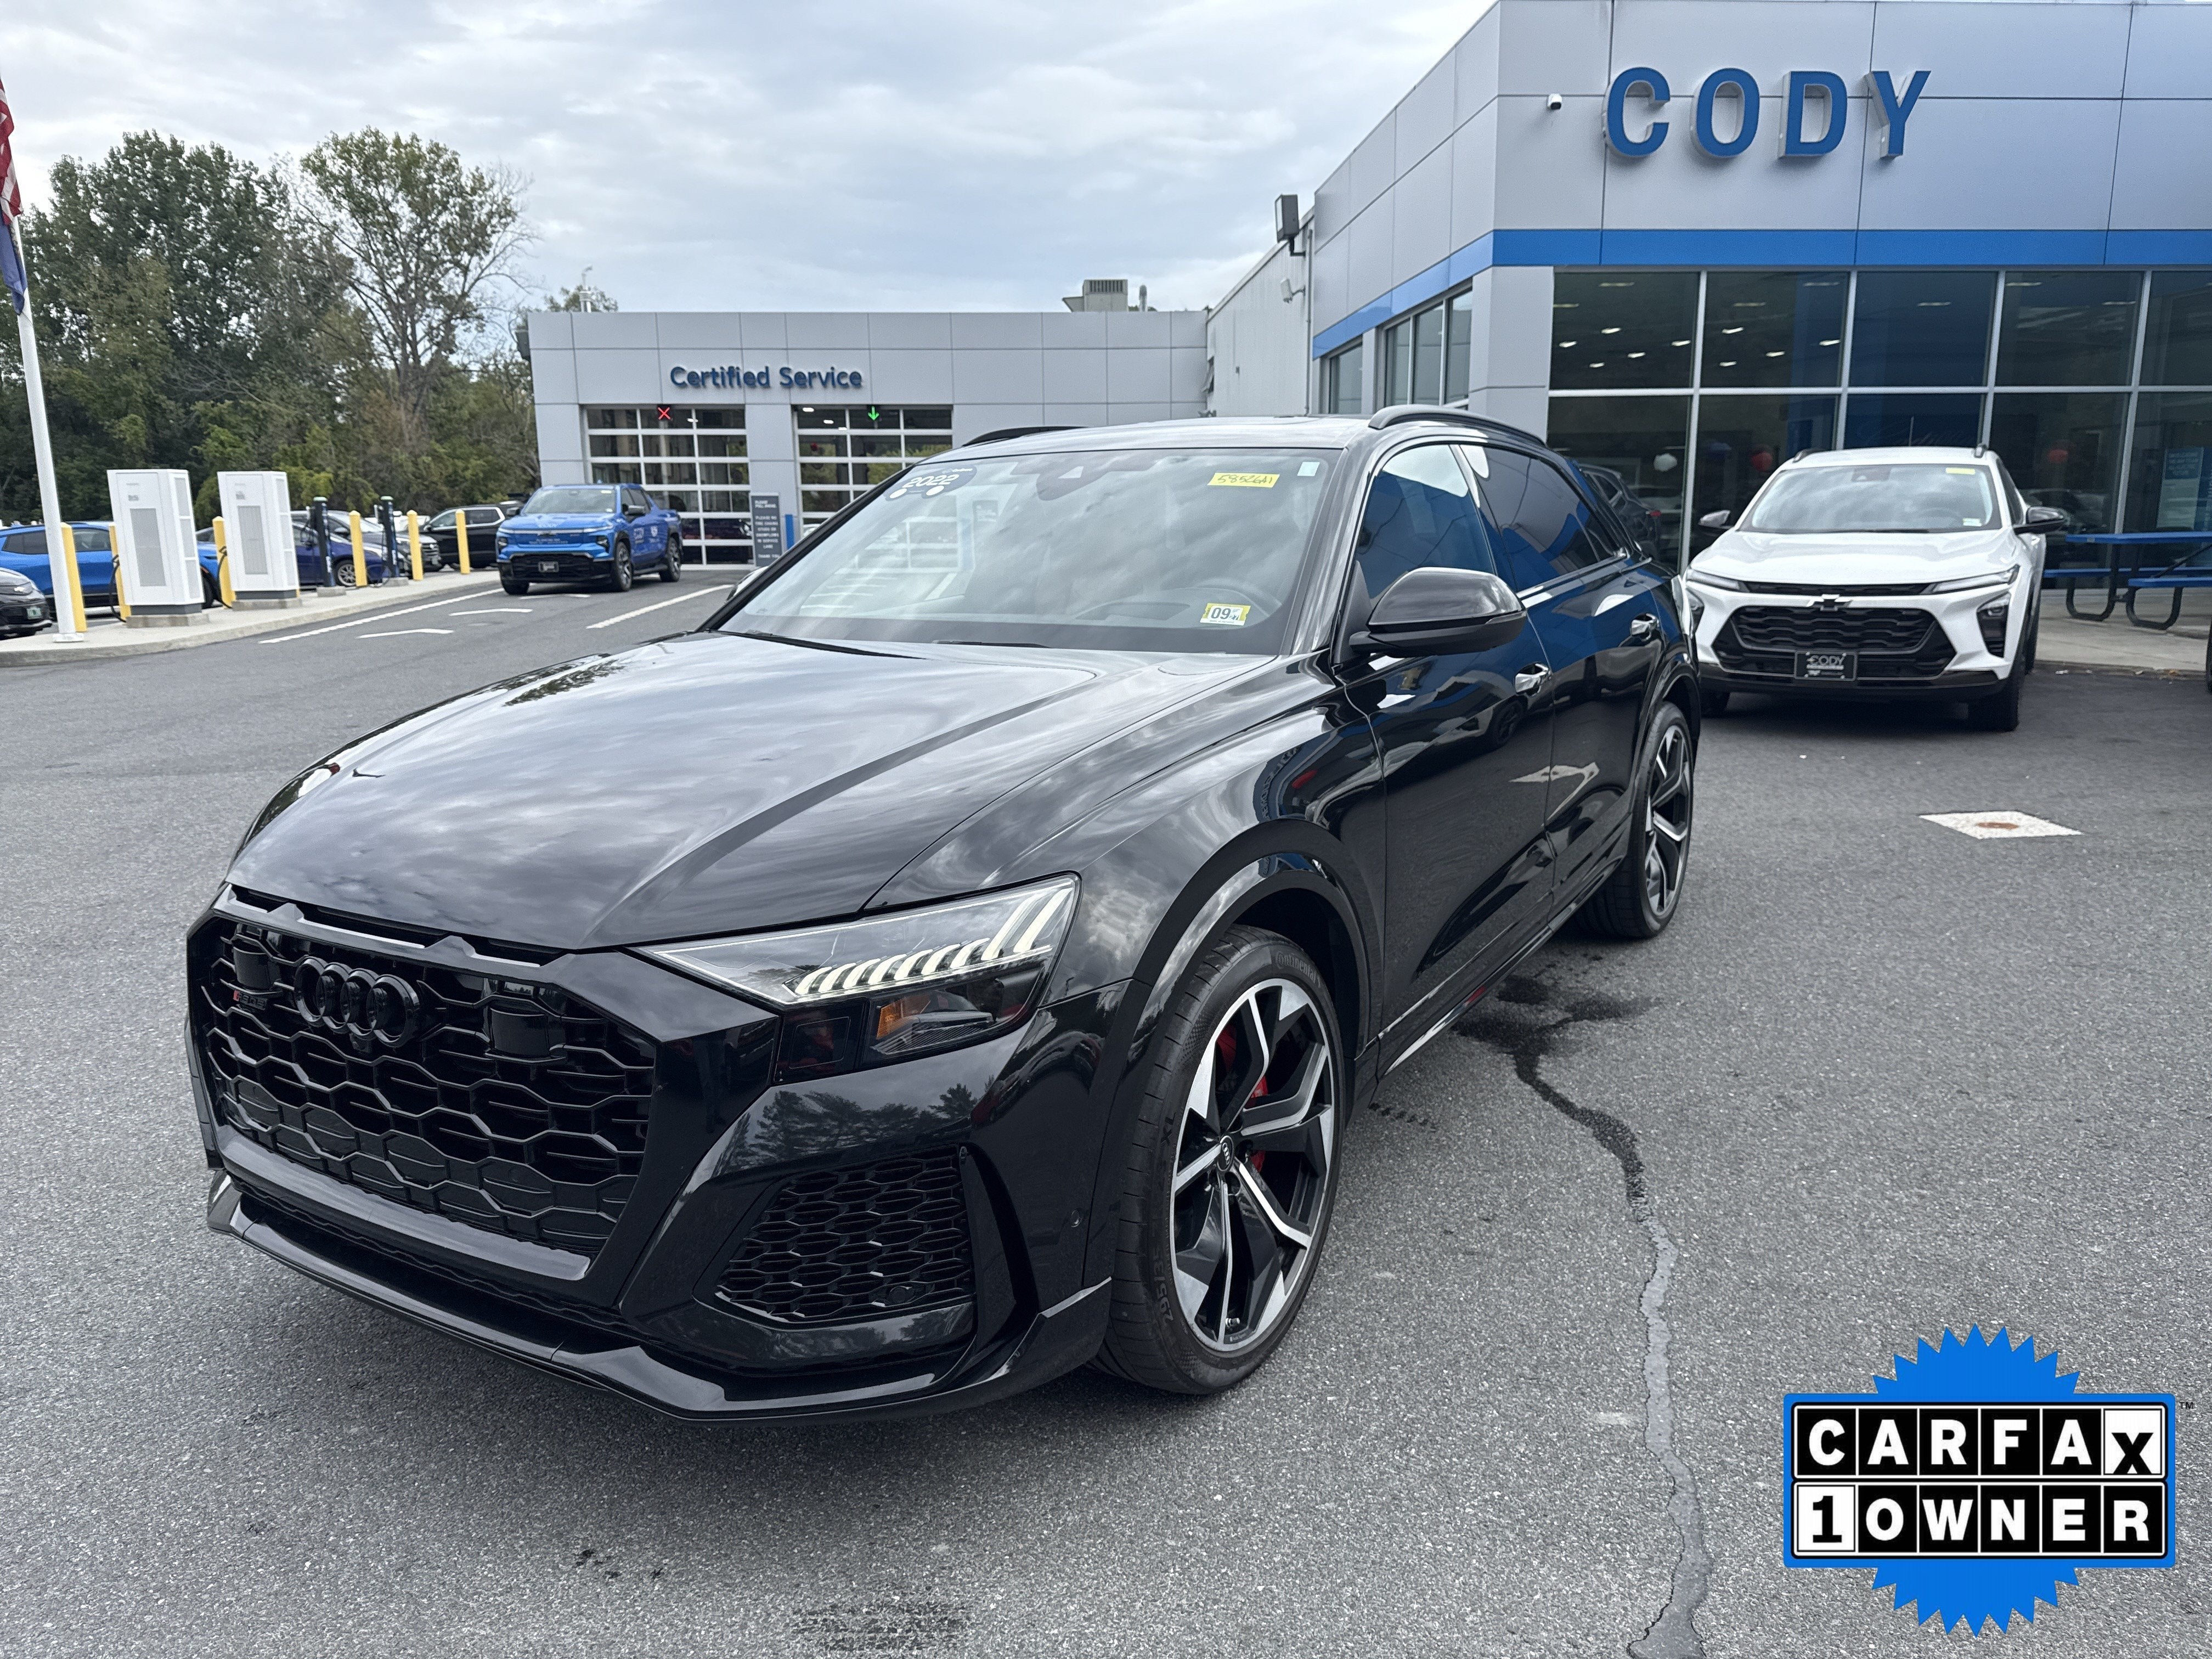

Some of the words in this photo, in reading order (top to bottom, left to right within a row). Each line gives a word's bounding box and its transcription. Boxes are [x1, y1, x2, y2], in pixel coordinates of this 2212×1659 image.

[1603, 66, 1931, 158] CODY
[670, 366, 771, 388] Certified
[779, 366, 862, 388] Service
[902, 474, 960, 488] 2022
[1211, 607, 1231, 619] 09
